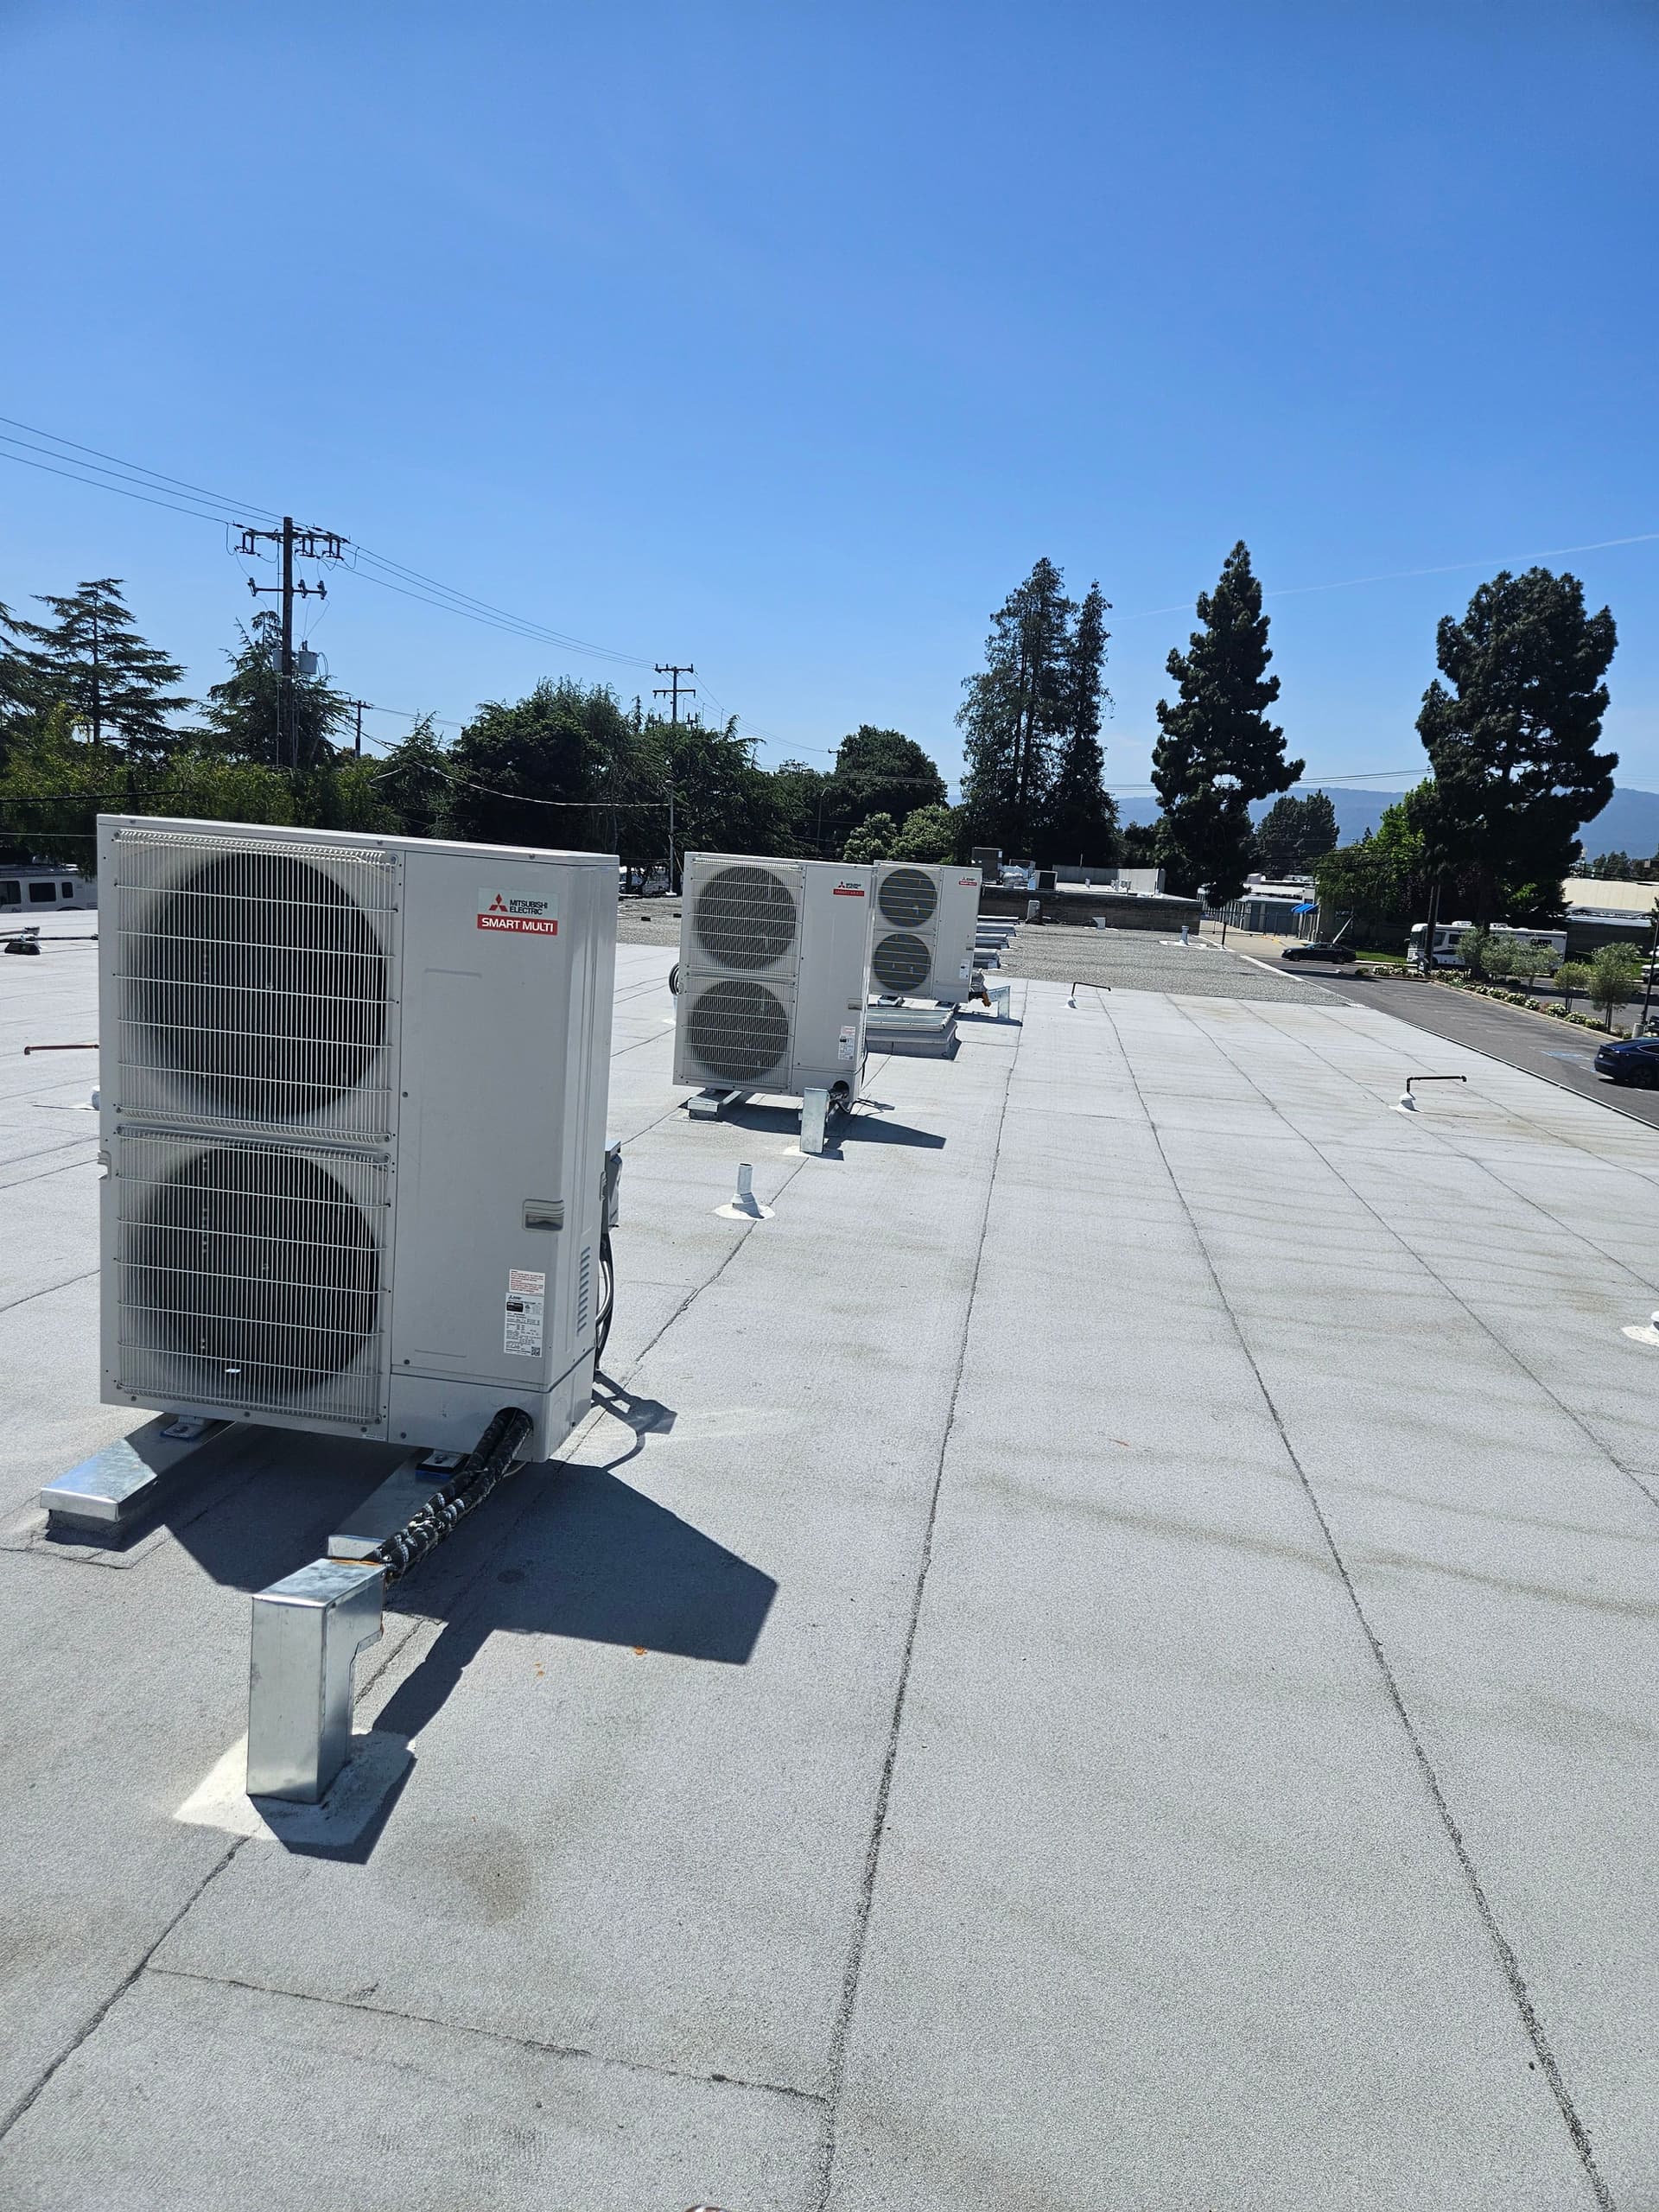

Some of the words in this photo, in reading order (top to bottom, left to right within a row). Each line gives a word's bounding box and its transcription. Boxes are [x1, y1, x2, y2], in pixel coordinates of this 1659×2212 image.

[510, 899, 548, 908] MITSUBISHI
[481, 918, 520, 930] SMART
[522, 920, 554, 932] MULTI
